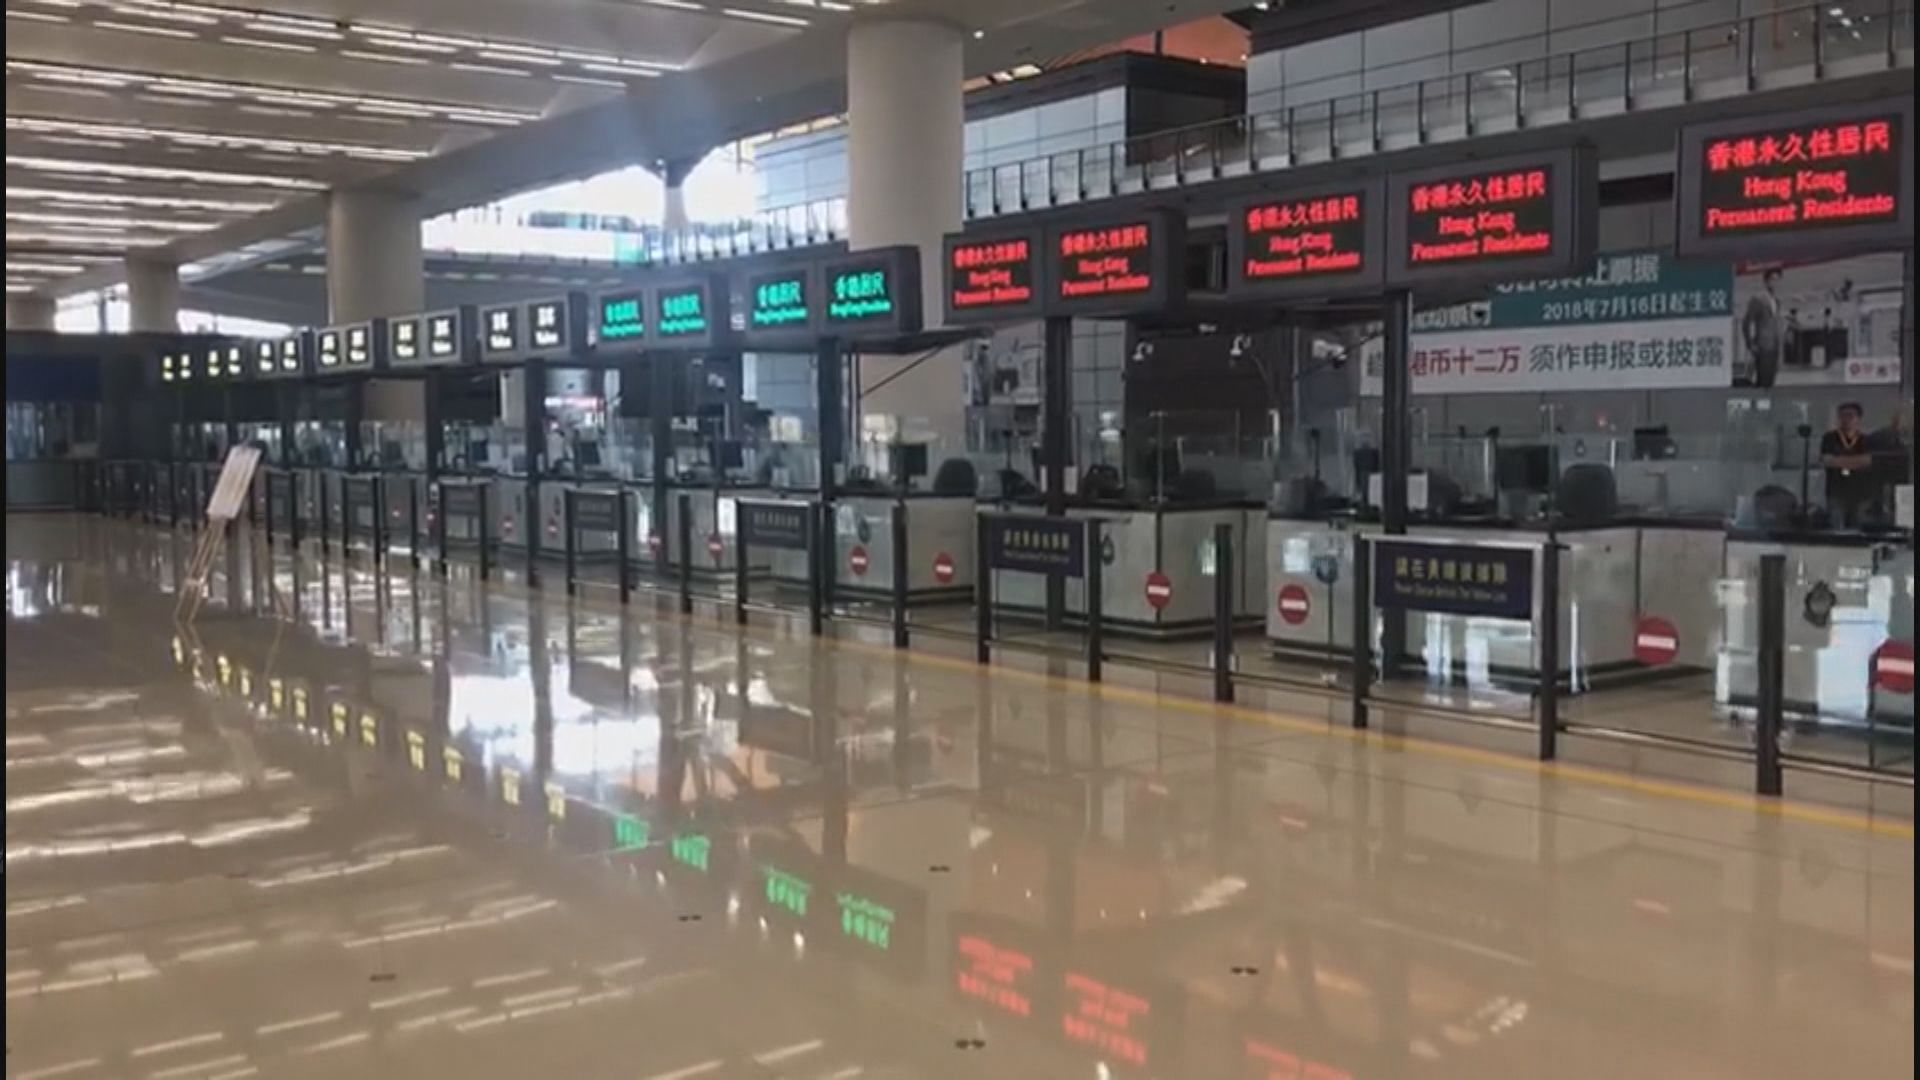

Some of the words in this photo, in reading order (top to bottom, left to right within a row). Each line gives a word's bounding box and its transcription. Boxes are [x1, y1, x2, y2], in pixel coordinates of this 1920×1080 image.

[1709, 122, 1888, 169] 香港永久性居民
[1413, 172, 1544, 210] 香港永久性居民
[1745, 177, 1791, 199] Hong
[1796, 171, 1846, 194] Kong
[1708, 204, 1796, 227] Permanent
[1803, 195, 1893, 218] Residents
[1542, 289, 1728, 321] 2018年7月16日起生效
[1528, 336, 1725, 374] 须作申报或披露
